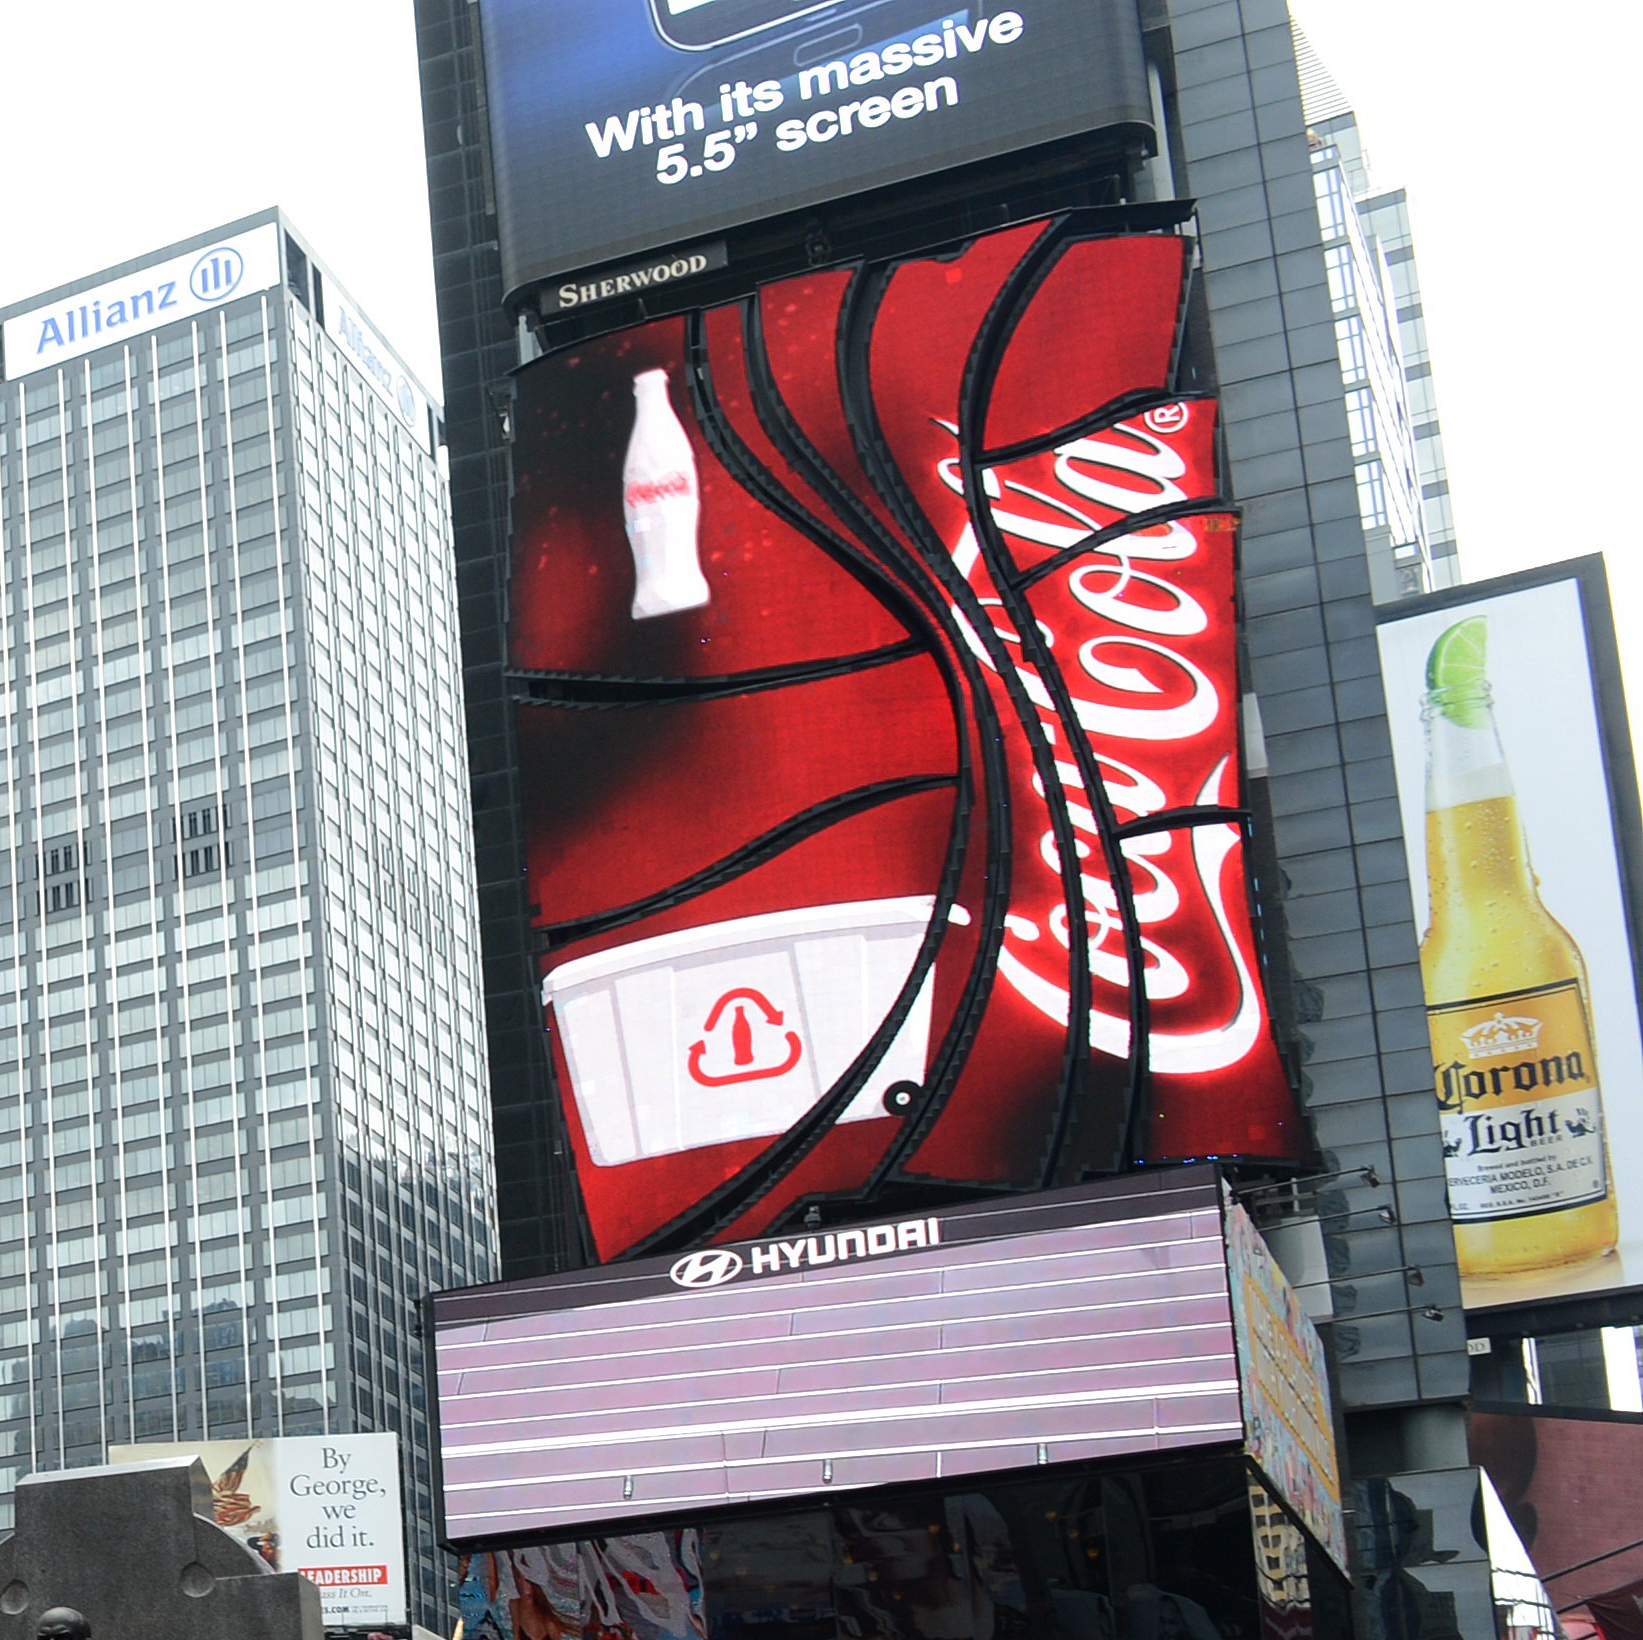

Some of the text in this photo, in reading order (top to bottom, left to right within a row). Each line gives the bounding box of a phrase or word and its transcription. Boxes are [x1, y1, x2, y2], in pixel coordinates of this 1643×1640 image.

[585, 9, 1024, 158] With its massive
[775, 76, 959, 153] screen
[558, 251, 708, 308] SHERWOOD
[37, 279, 177, 355] Allianz
[1434, 1051, 1586, 1115] Corona
[1463, 1107, 1561, 1157] Light
[1529, 1135, 1563, 1148] BEER
[1489, 1180, 1531, 1195] MEXICO,
[751, 1218, 941, 1276] HYUNDAI
[322, 1447, 351, 1474] By
[290, 1474, 387, 1500] George,
[323, 1504, 356, 1520] we
[306, 1525, 375, 1549] did it.
